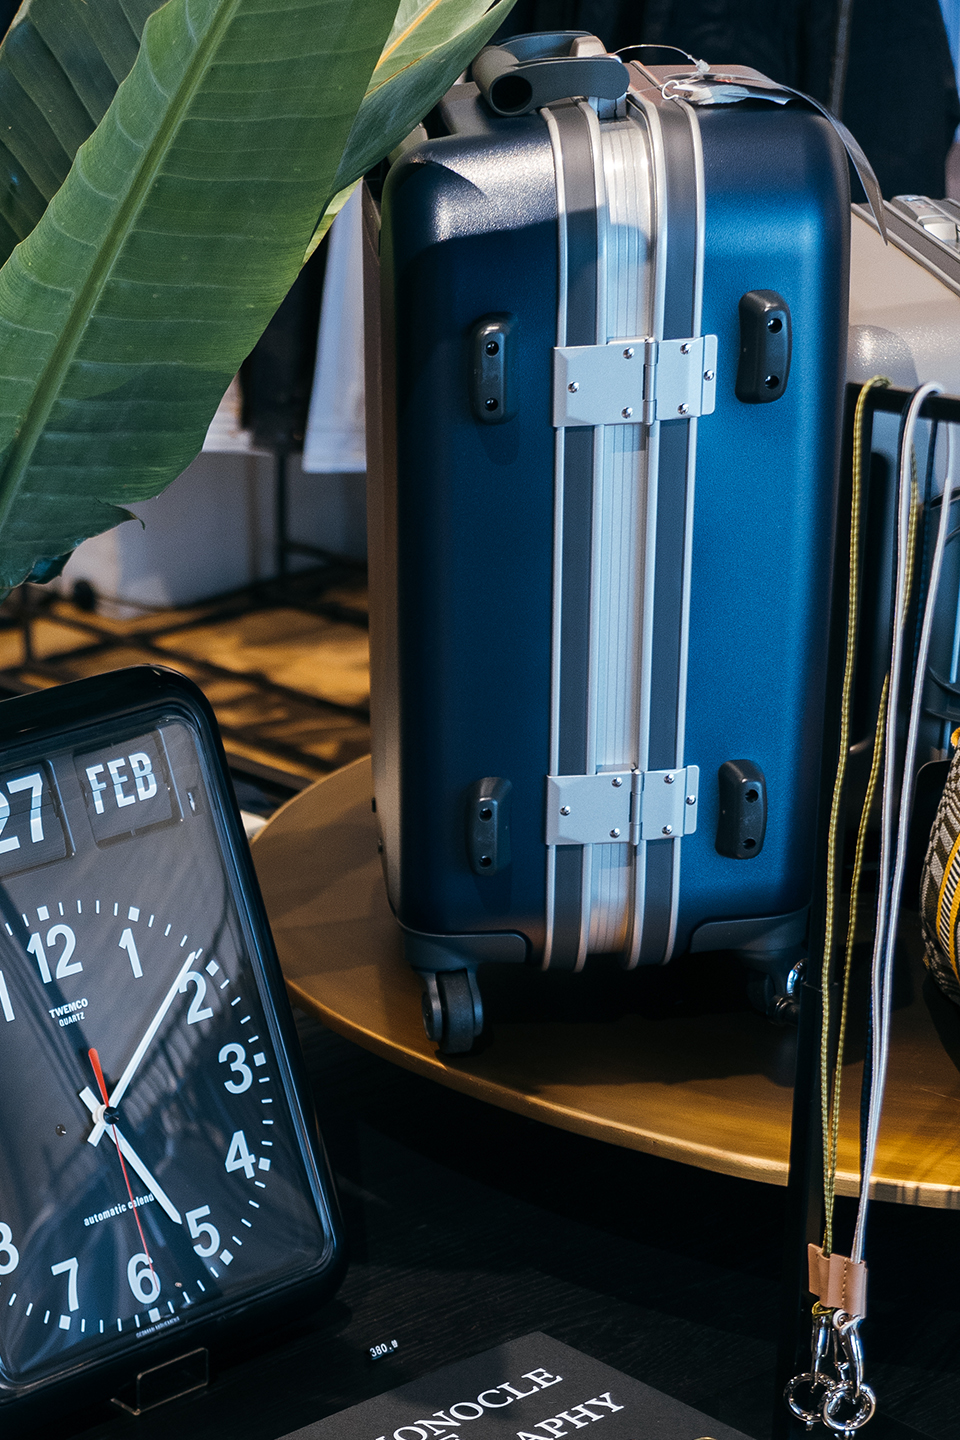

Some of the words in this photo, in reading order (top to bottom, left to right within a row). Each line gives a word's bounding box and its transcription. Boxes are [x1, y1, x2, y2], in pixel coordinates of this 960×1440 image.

[85, 752, 158, 816] FEB
[26, 922, 84, 984] 12
[118, 927, 143, 979] 1
[48, 997, 89, 1019] TWEMCO
[58, 1011, 86, 1027] QUARTZ
[177, 969, 213, 1025] 2
[218, 1042, 254, 1095] 3
[224, 1130, 257, 1179] 4
[83, 1203, 127, 1227] automatic
[127, 1193, 155, 1210] calend
[188, 1205, 221, 1260] 5
[51, 1257, 81, 1311] 7
[127, 1252, 162, 1304] 6
